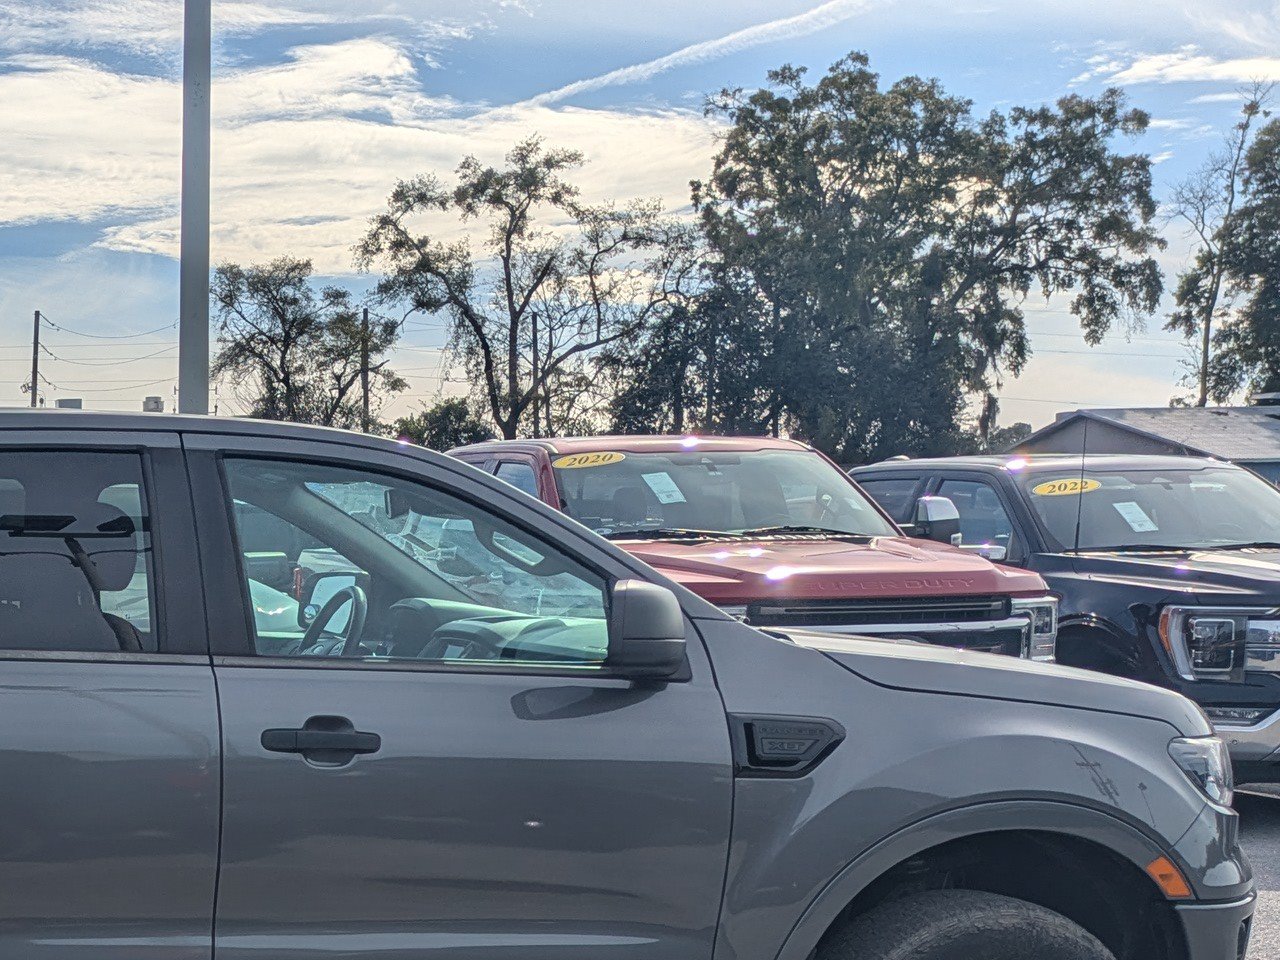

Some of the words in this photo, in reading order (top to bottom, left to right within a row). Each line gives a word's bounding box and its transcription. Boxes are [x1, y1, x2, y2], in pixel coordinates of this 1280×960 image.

[566, 453, 614, 467] 2020
[1047, 480, 1089, 494] 2022
[904, 577, 975, 589] DUTY
[768, 740, 806, 752] XLT
